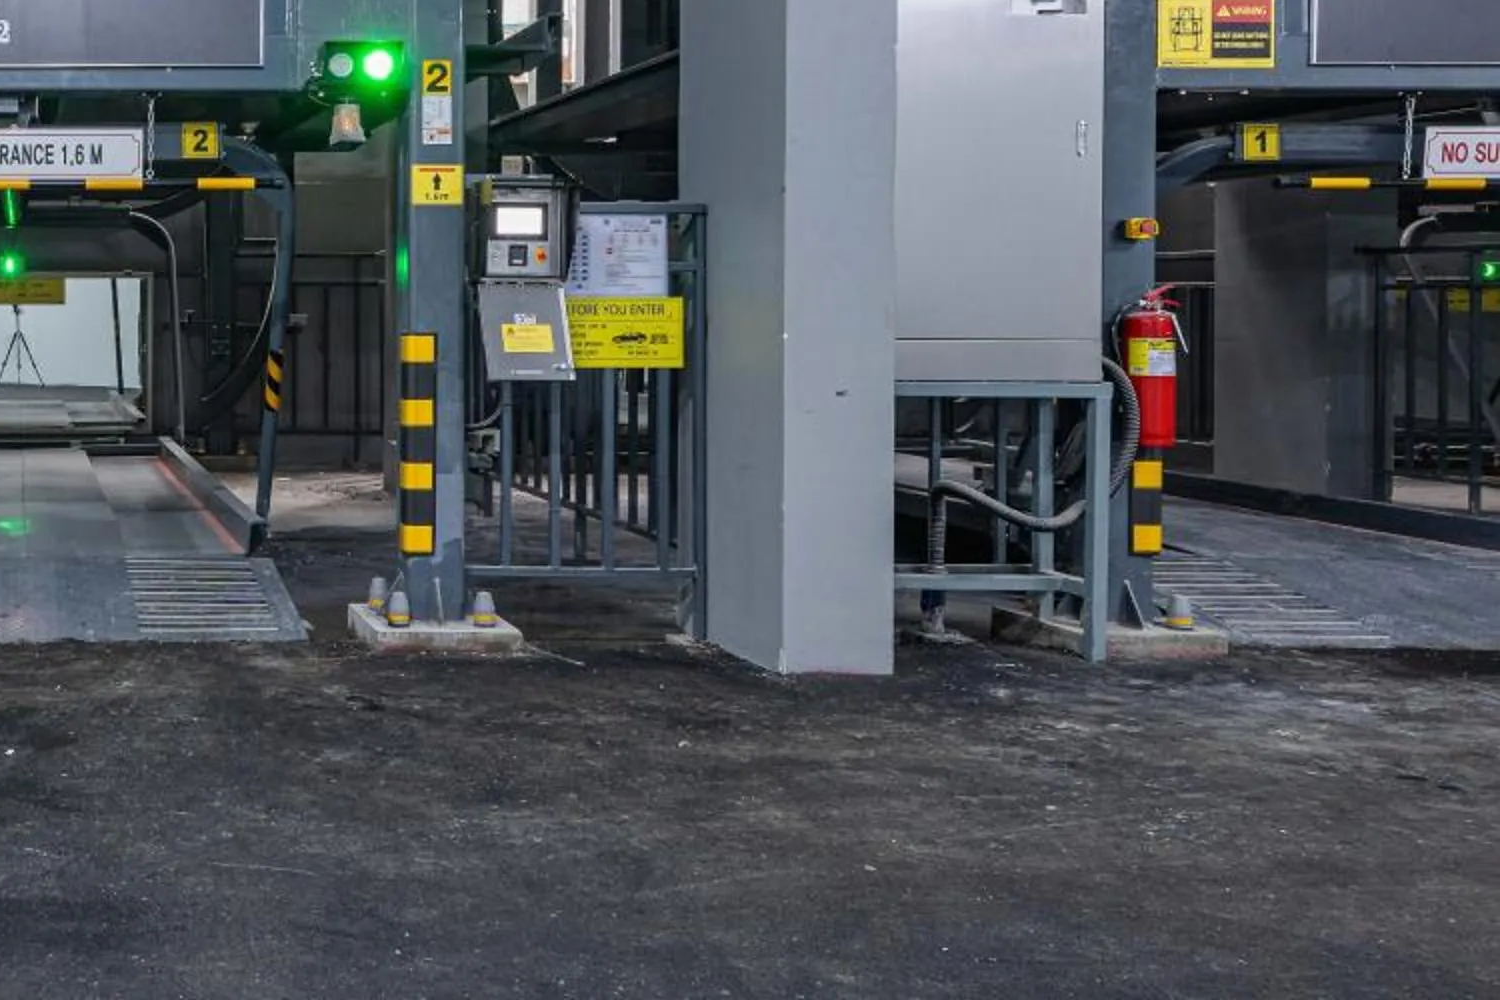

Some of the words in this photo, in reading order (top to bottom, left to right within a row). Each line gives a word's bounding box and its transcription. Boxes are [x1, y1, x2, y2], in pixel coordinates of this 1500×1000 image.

[426, 63, 448, 92] 2
[193, 130, 209, 152] 2
[1255, 130, 1267, 152] 1
[1441, 141, 1469, 163] NO
[61, 143, 85, 167] 1.6
[91, 143, 103, 165] M
[603, 303, 628, 316] YOU
[630, 303, 665, 316] ENTER
